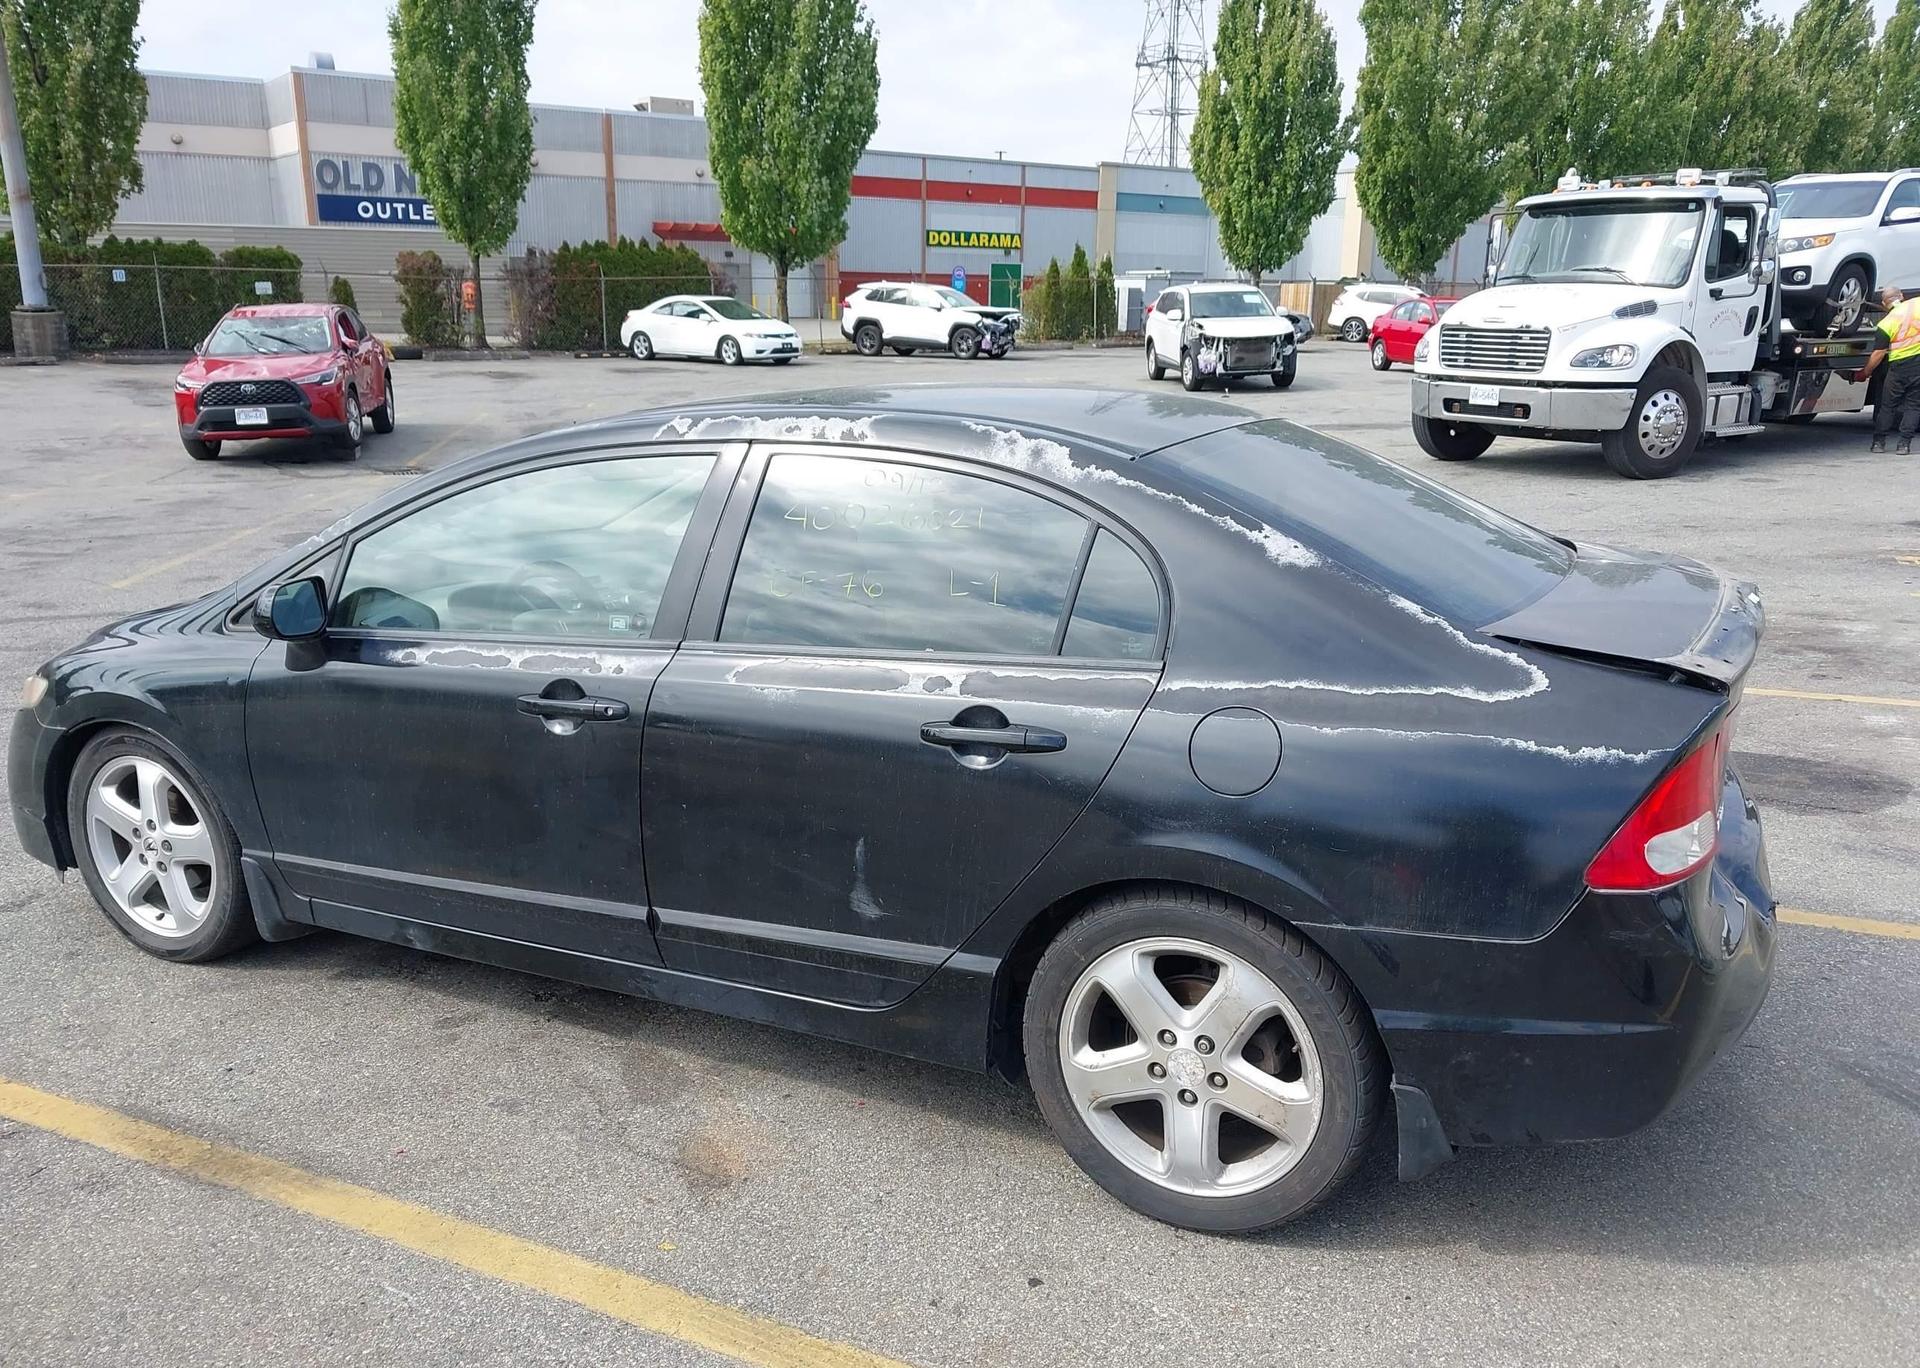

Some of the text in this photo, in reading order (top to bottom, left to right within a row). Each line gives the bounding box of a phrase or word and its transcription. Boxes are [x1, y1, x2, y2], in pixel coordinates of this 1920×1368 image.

[316, 158, 384, 191] OLD
[357, 201, 435, 221] OUTLE
[928, 231, 1021, 248] DOLLARAMA
[949, 569, 1006, 607] L-1
